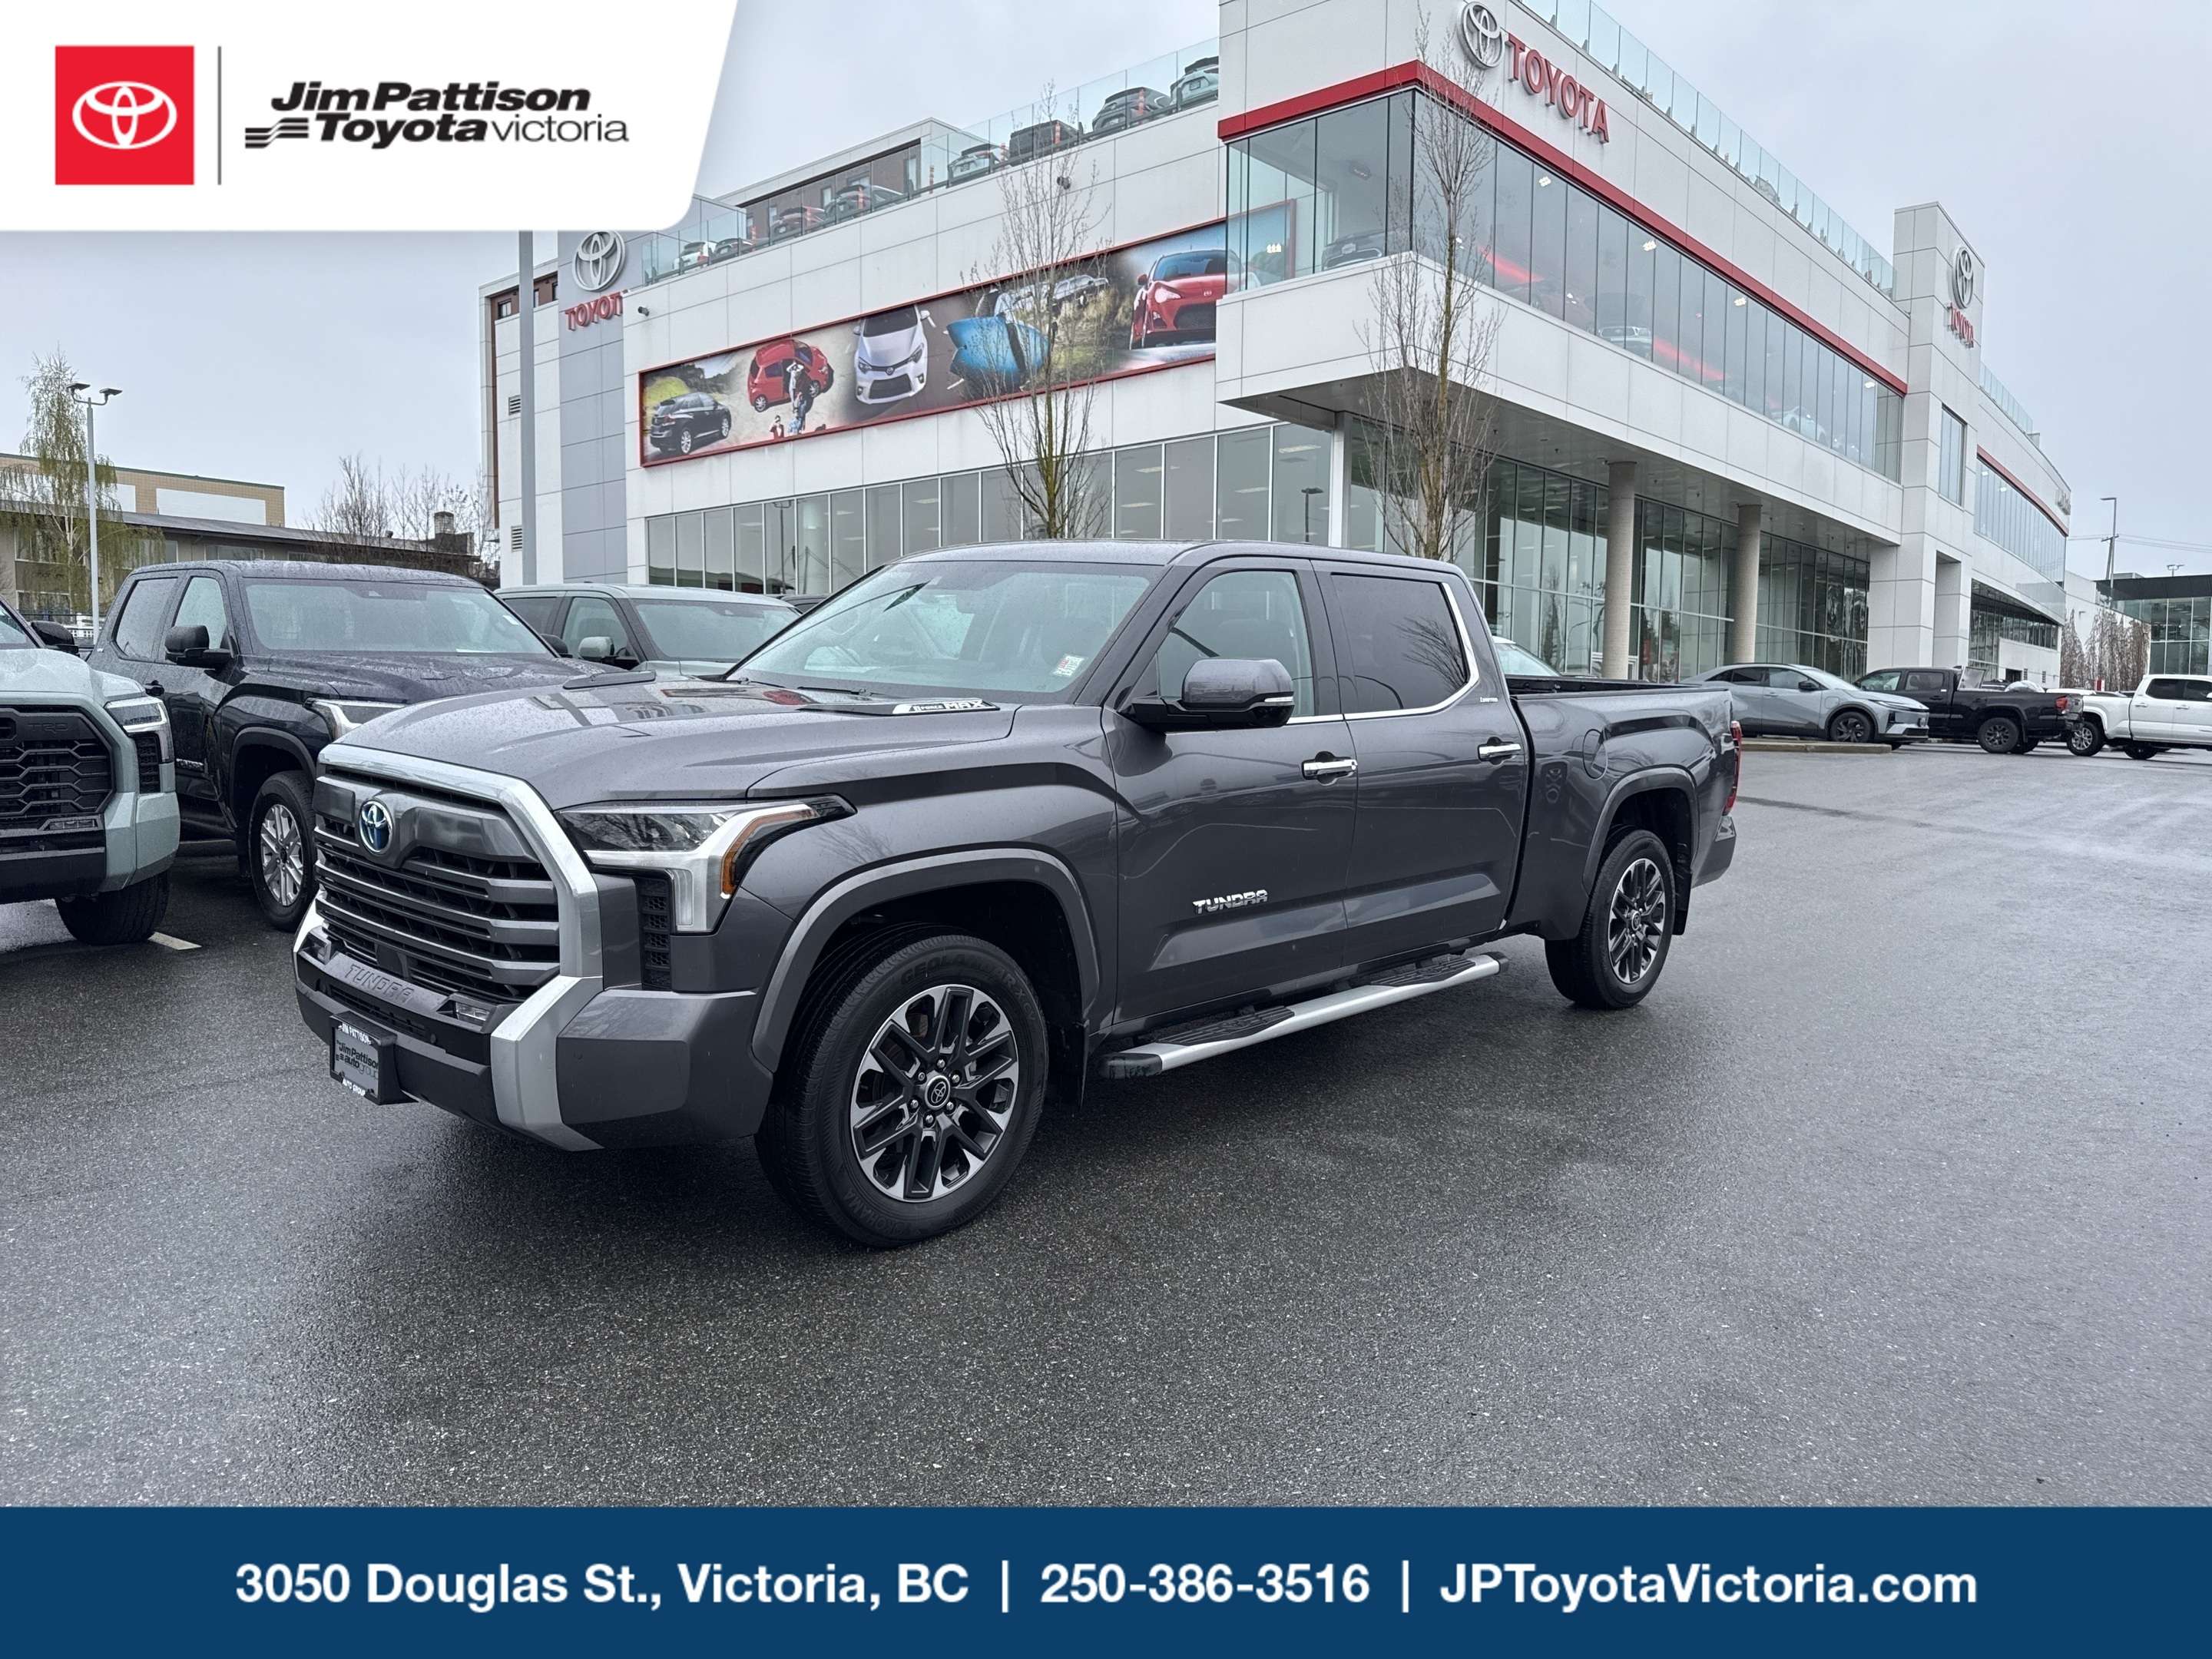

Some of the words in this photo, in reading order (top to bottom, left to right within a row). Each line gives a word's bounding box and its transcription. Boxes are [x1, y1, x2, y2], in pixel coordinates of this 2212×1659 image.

[1505, 32, 1610, 144] TOYOTA
[565, 292, 623, 331] TOYOT
[28, 723, 68, 733] TRD
[1192, 889, 1268, 914] TUNDRA
[344, 964, 415, 1004] TUNDRA
